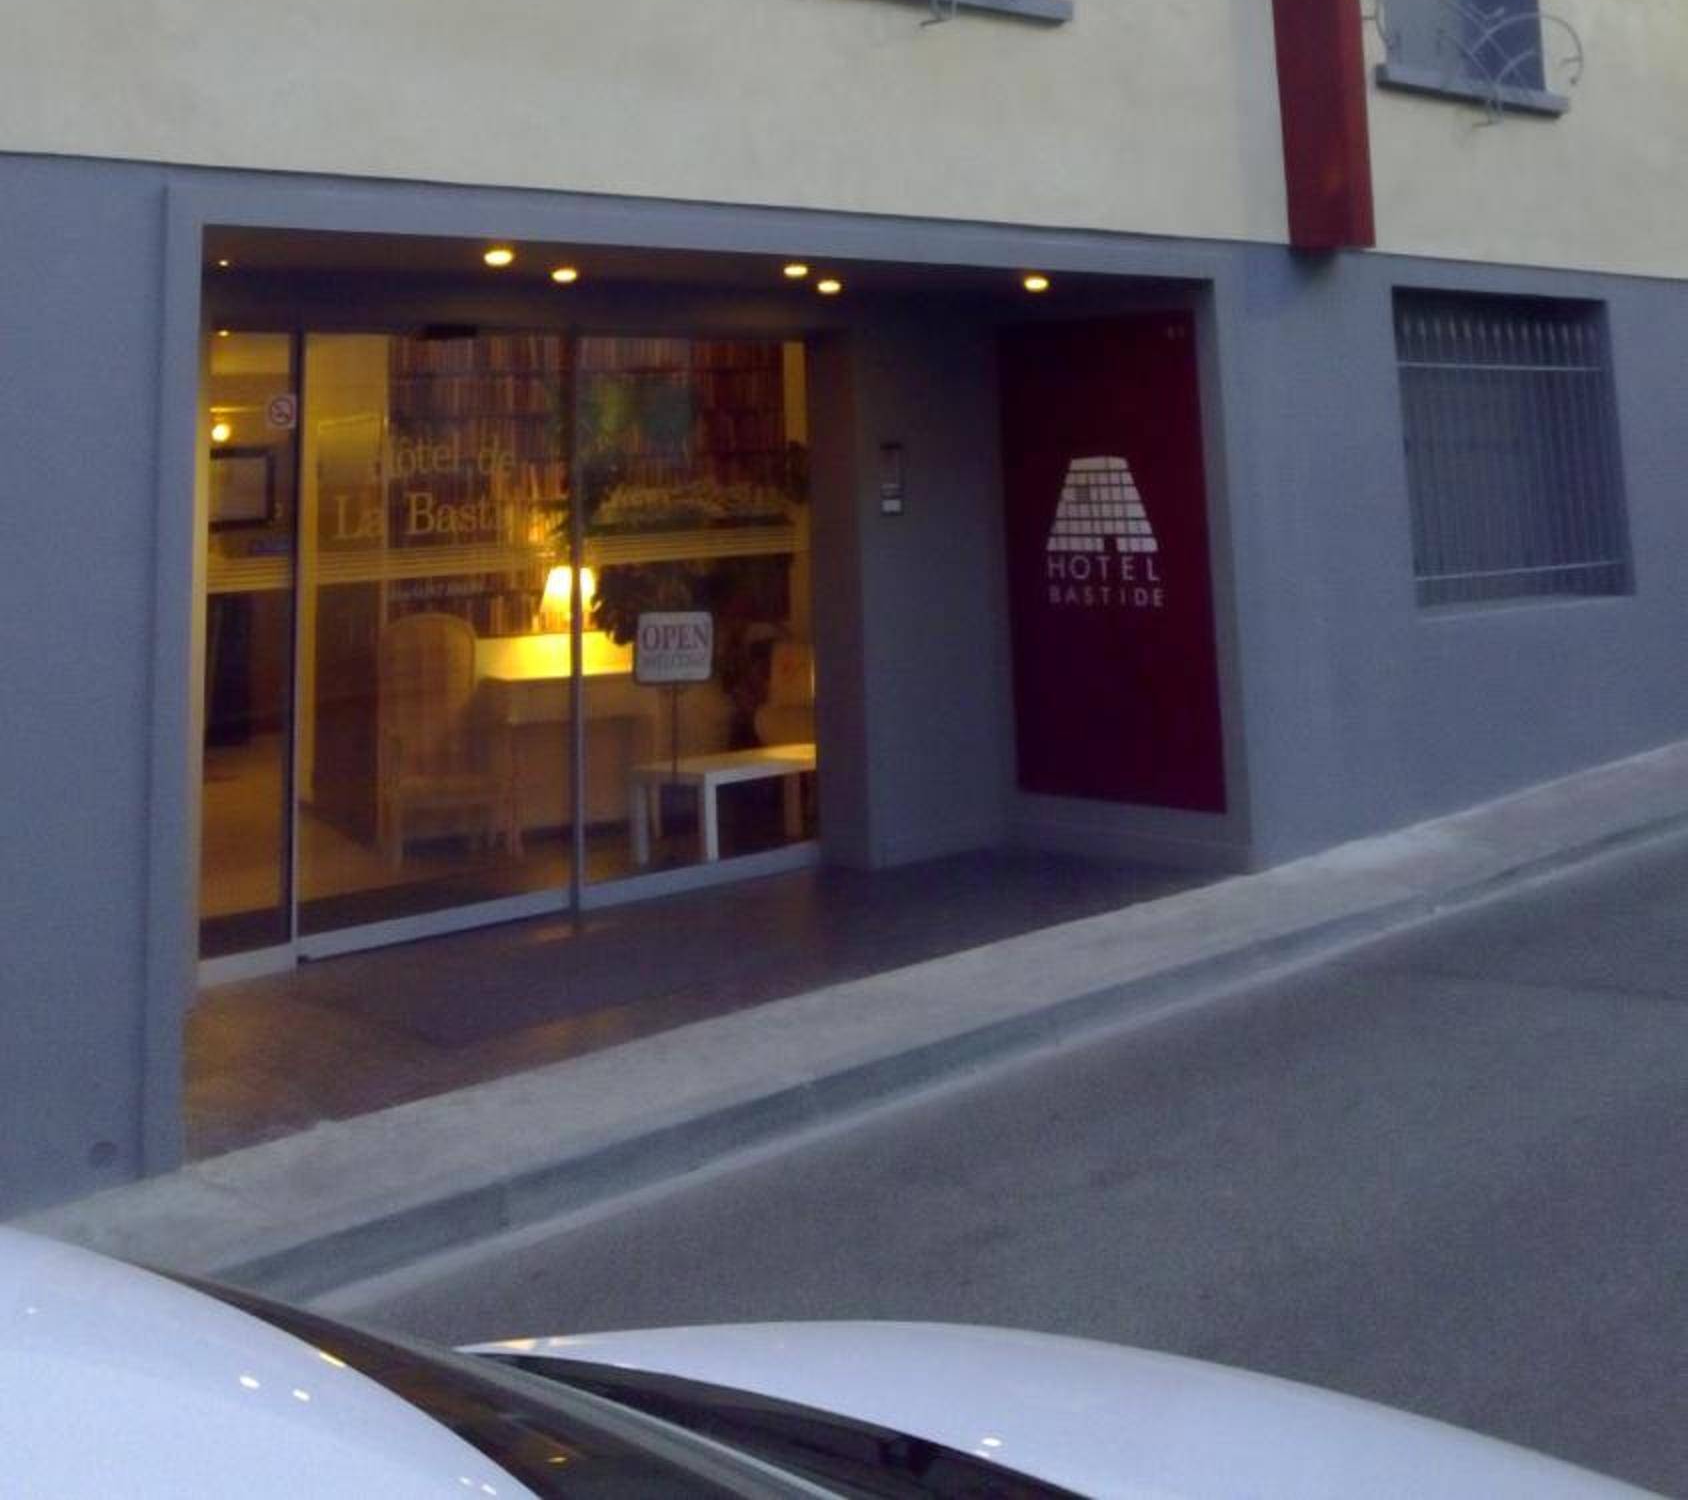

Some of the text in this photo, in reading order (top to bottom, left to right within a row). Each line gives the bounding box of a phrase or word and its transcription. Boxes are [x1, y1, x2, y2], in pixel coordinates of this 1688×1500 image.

[332, 493, 386, 540] La
[1046, 554, 1161, 582] HOTEL
[1049, 584, 1166, 608] BASTIDE
[641, 622, 710, 652] OPEN
